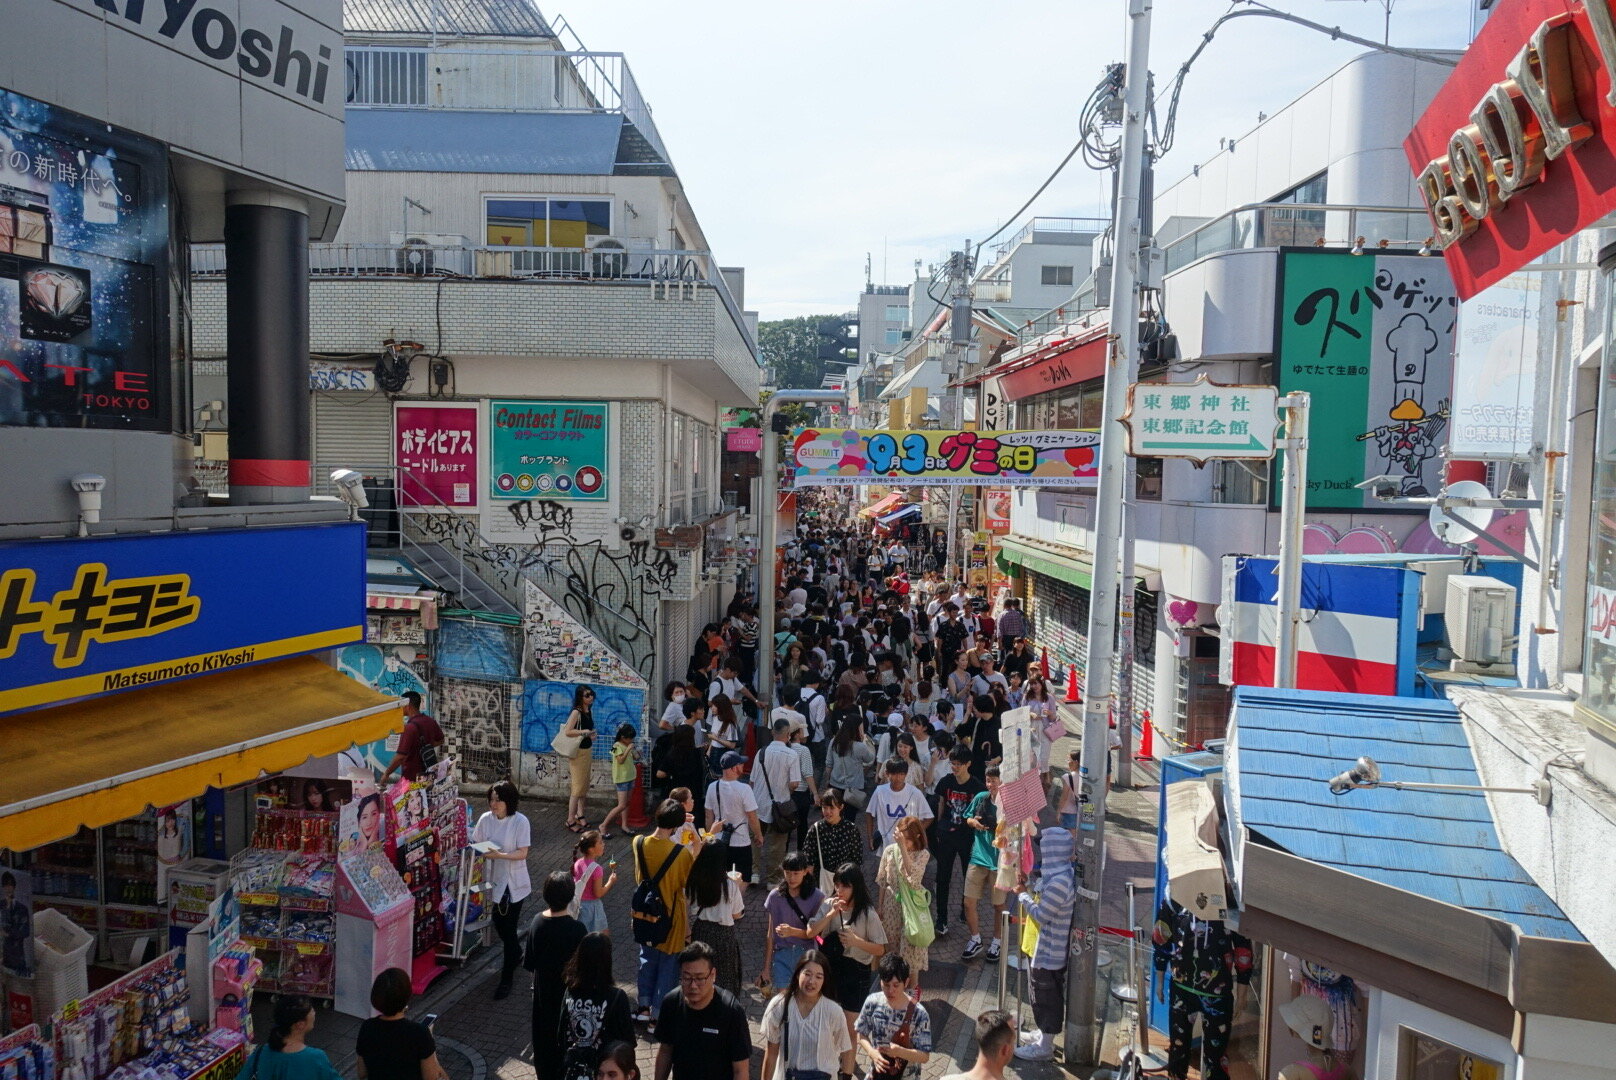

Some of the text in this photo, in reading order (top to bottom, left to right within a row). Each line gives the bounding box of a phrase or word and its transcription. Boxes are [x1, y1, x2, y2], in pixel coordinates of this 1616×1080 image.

[0, 149, 132, 203] の新時代へ。
[82, 394, 150, 409] TOKYO
[1142, 394, 1250, 412] 東郷神社
[496, 408, 603, 429] Contact Films
[1142, 418, 1250, 436] 東郷記念館
[800, 448, 840, 457] GUMMIT
[103, 648, 256, 692] Matsumoto KiYoshi
